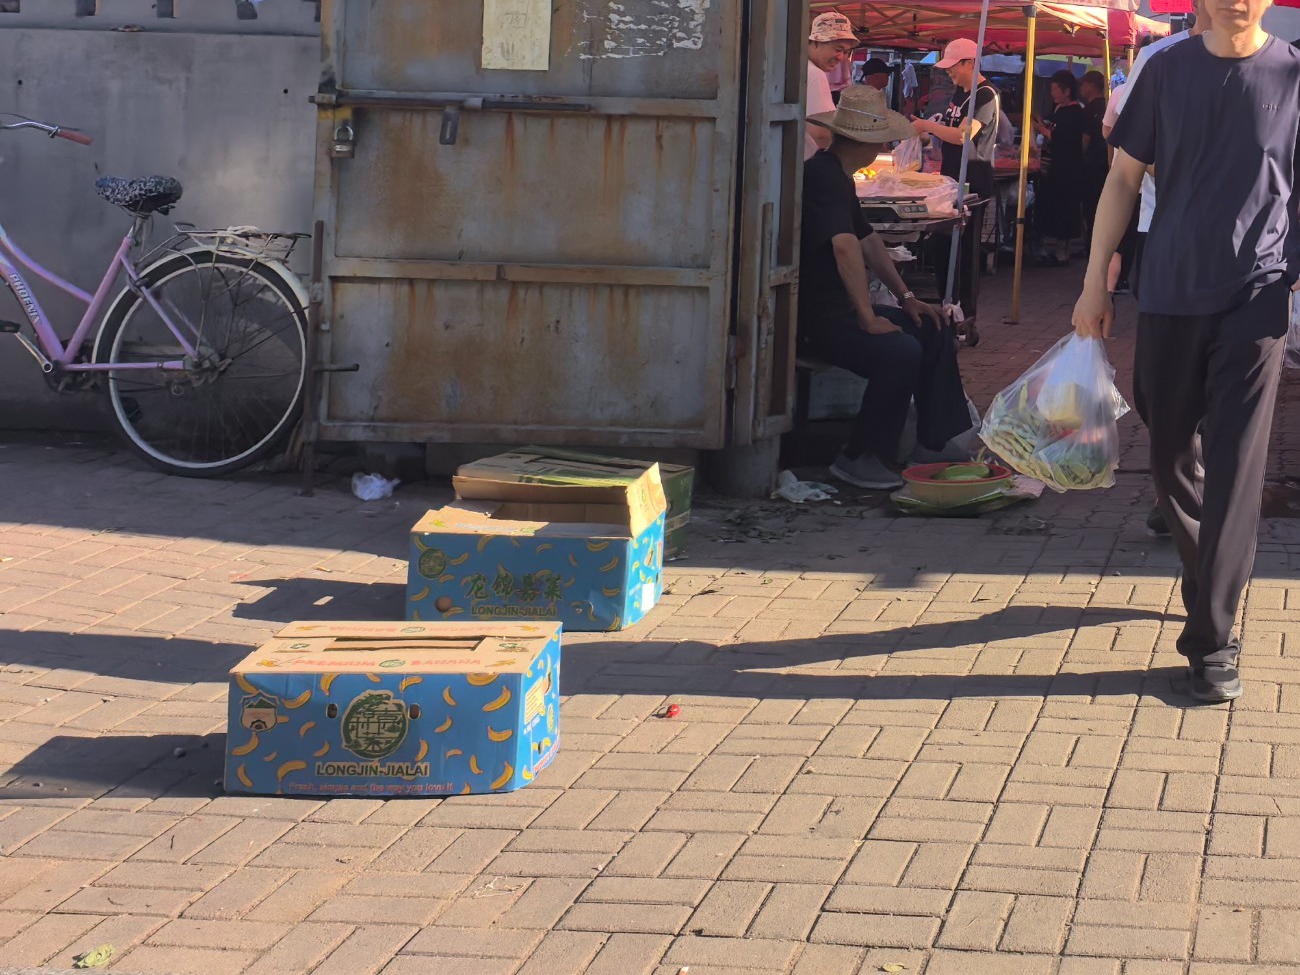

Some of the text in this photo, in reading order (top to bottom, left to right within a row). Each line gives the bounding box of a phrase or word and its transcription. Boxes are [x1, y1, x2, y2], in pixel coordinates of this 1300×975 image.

[9, 273, 42, 324] PHOENIX
[471, 606, 556, 617] LONGJIN-JIALAI
[410, 658, 481, 666] BANANA
[316, 764, 429, 776] LONGJIN-JIALAI
